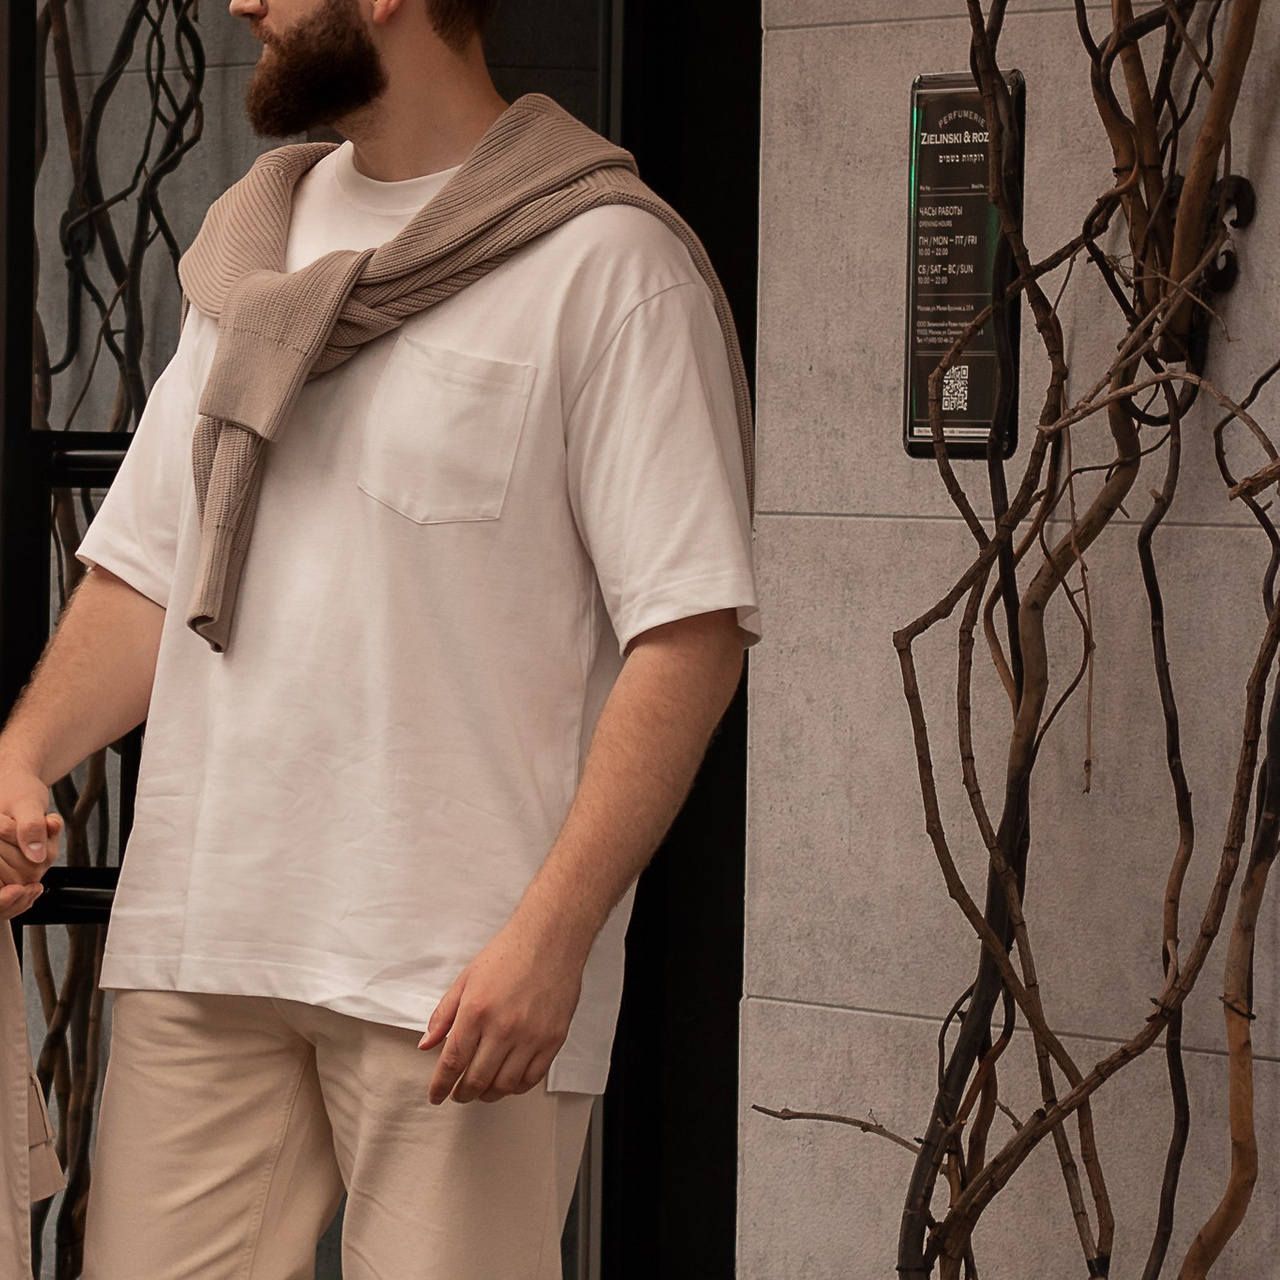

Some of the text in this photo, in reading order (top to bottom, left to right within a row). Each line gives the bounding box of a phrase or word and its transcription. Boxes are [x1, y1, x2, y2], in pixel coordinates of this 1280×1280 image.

[938, 109, 986, 128] PERFUMERIE
[963, 131, 971, 143] &
[919, 205, 963, 216] ЧАСЫ РАБОТЫ
